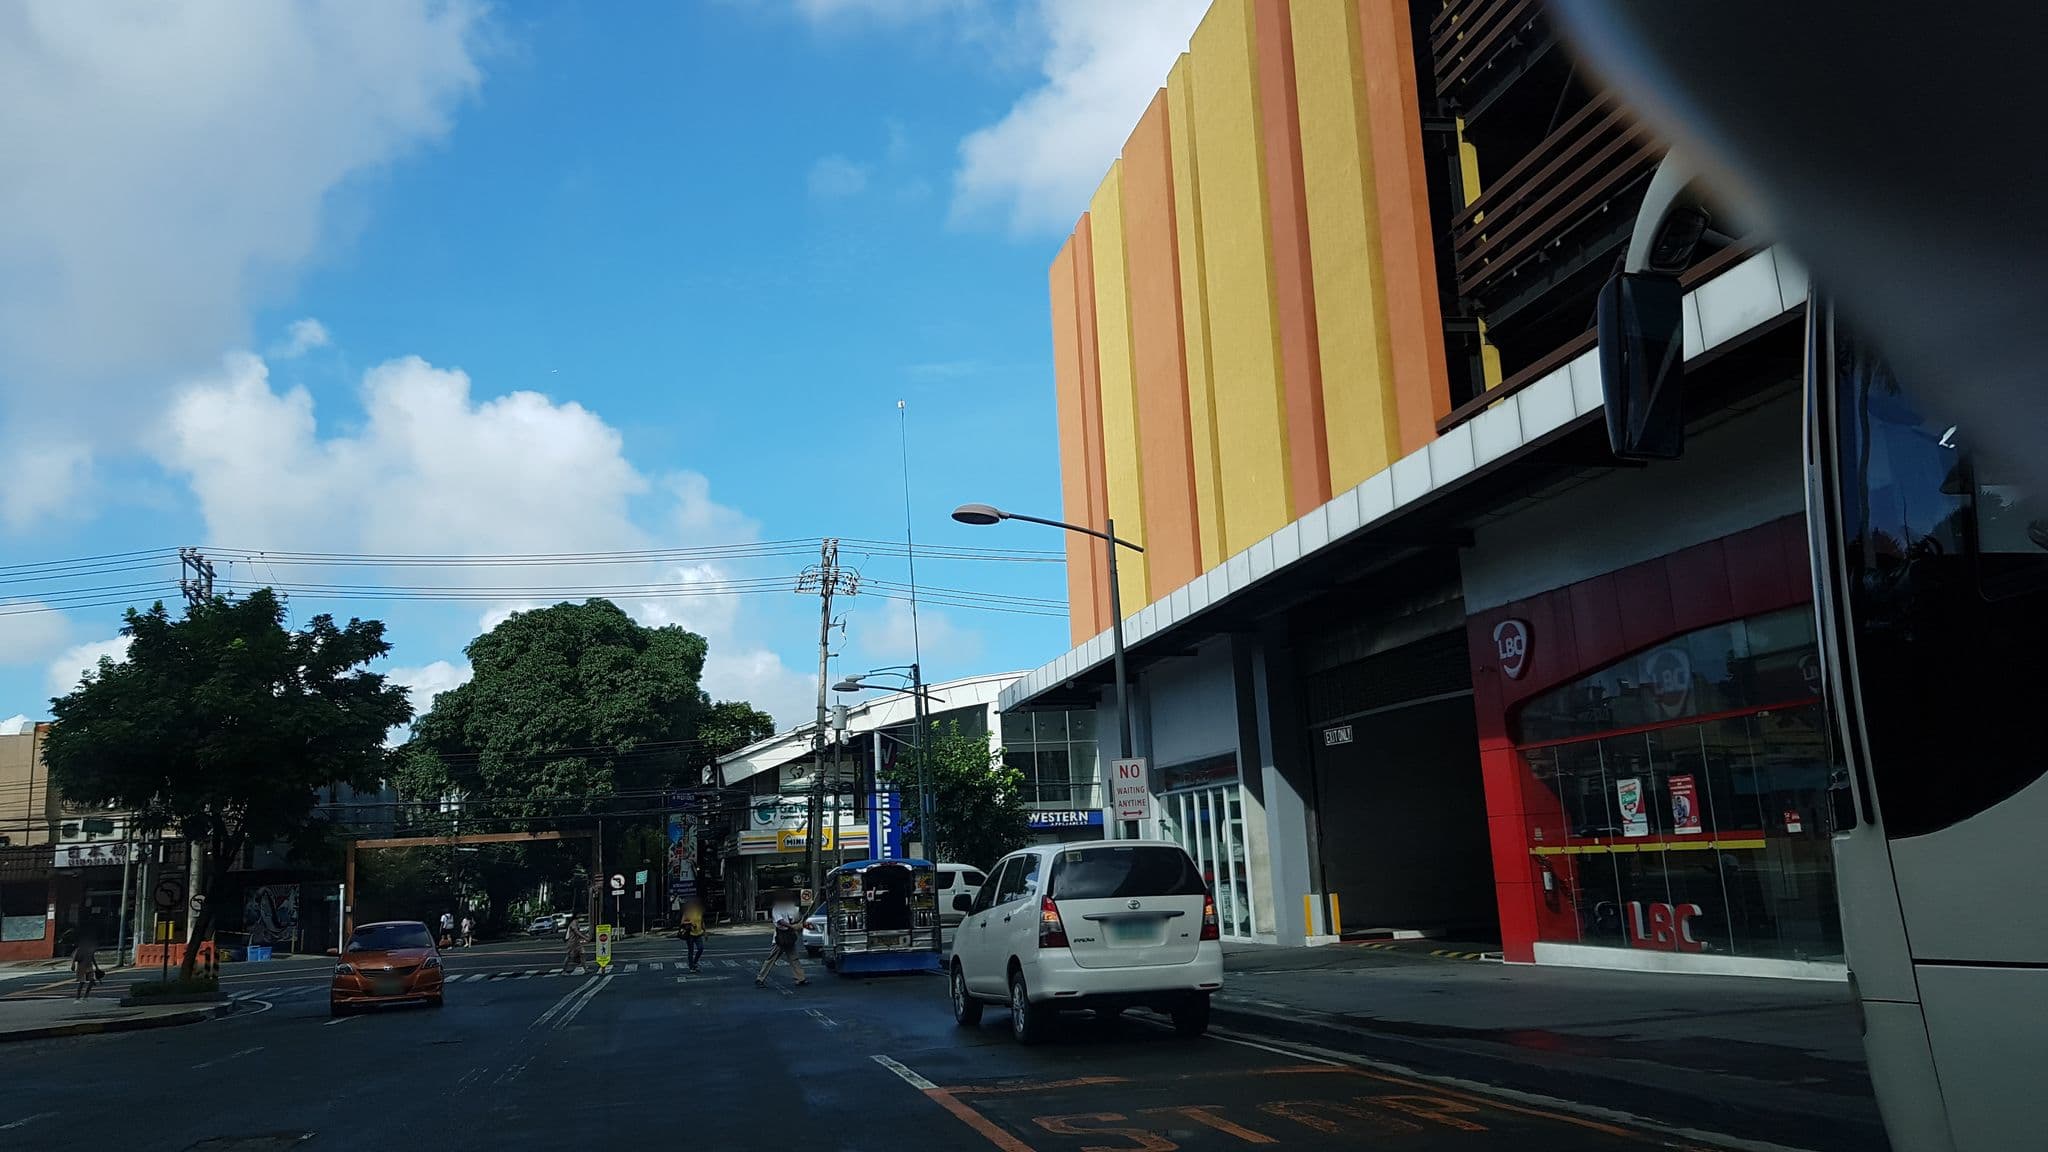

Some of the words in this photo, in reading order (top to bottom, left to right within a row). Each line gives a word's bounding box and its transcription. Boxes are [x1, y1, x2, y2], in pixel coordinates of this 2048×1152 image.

[1499, 635, 1523, 659] LBC
[1326, 731, 1337, 743] EXIT
[1338, 728, 1350, 741] ONLY
[1119, 764, 1140, 778] NO
[1117, 786, 1145, 795] WAITING
[1119, 799, 1146, 808] ANYTIME
[1028, 811, 1089, 823] WESTERN
[786, 837, 805, 846] MINI
[1628, 901, 1707, 951] LBC
